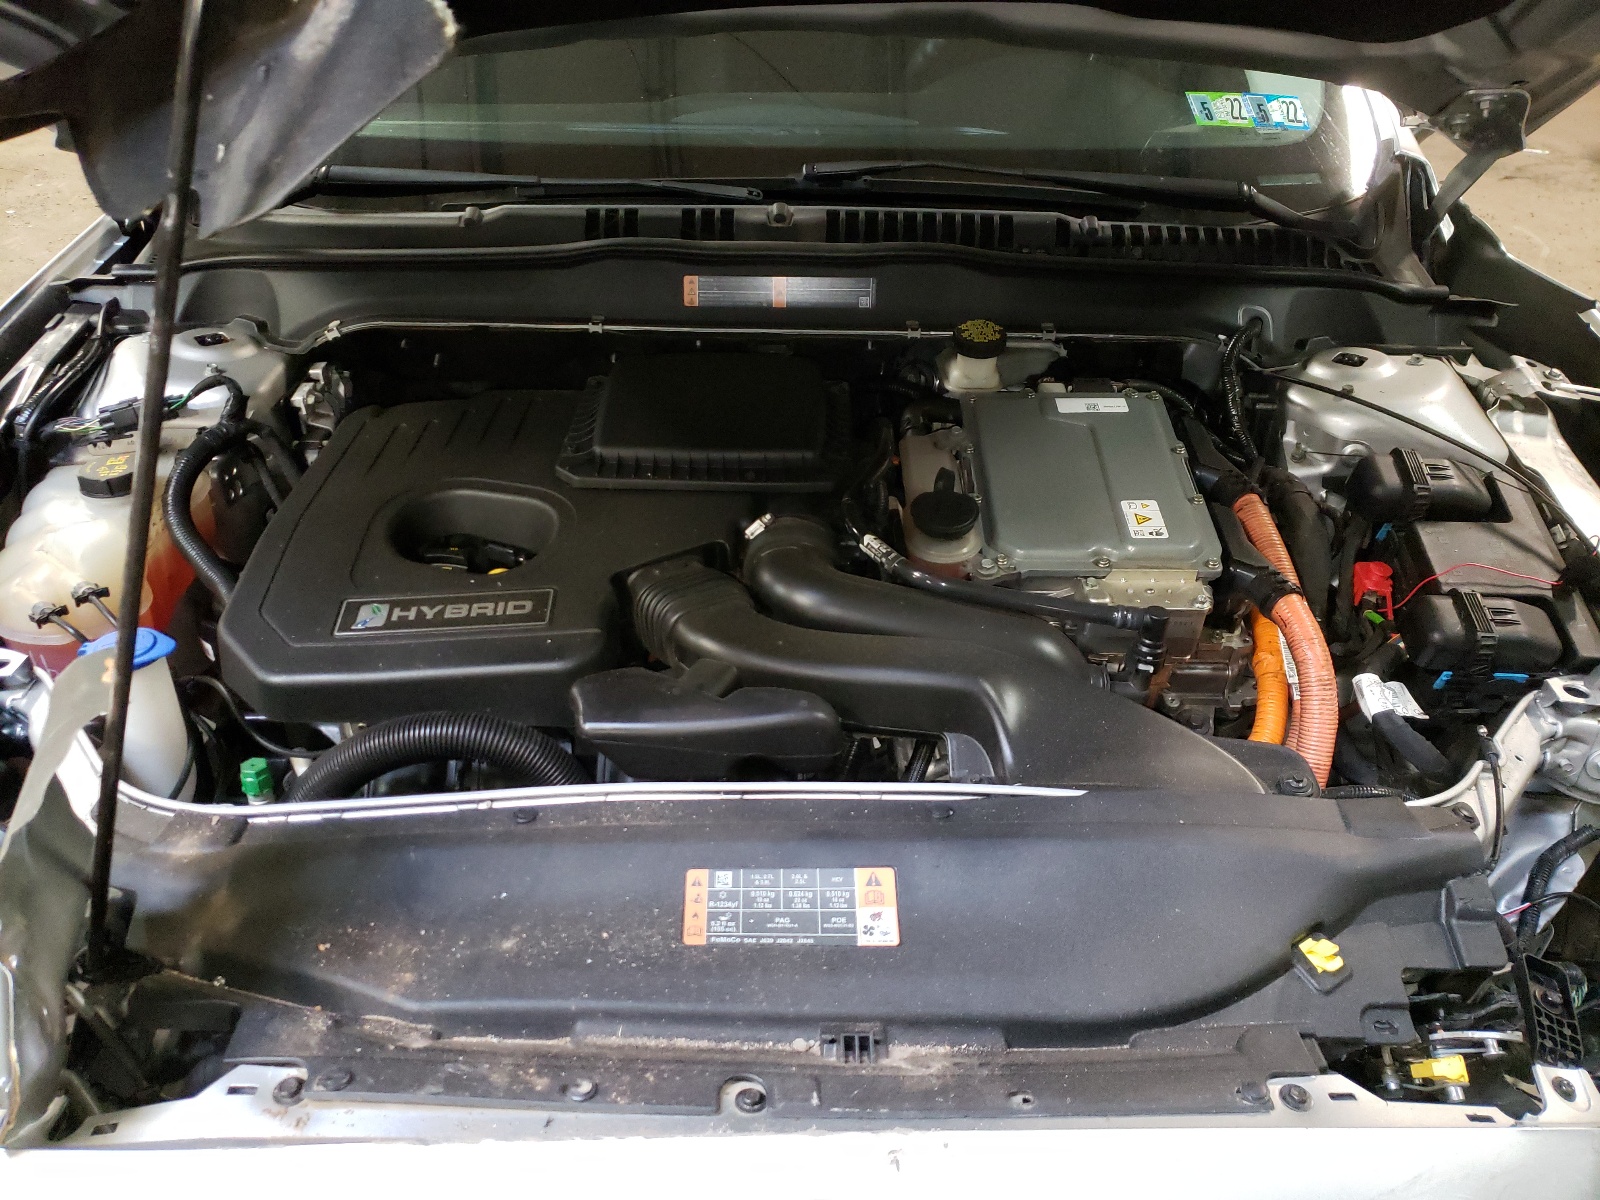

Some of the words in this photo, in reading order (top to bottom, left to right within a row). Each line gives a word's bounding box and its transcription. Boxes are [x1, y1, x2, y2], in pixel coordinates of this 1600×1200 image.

[1200, 101, 1214, 121] 5
[1226, 98, 1248, 120] 22
[1280, 100, 1302, 124] 22
[391, 600, 533, 621] HYBRID
[708, 900, 738, 909] R-1234yf
